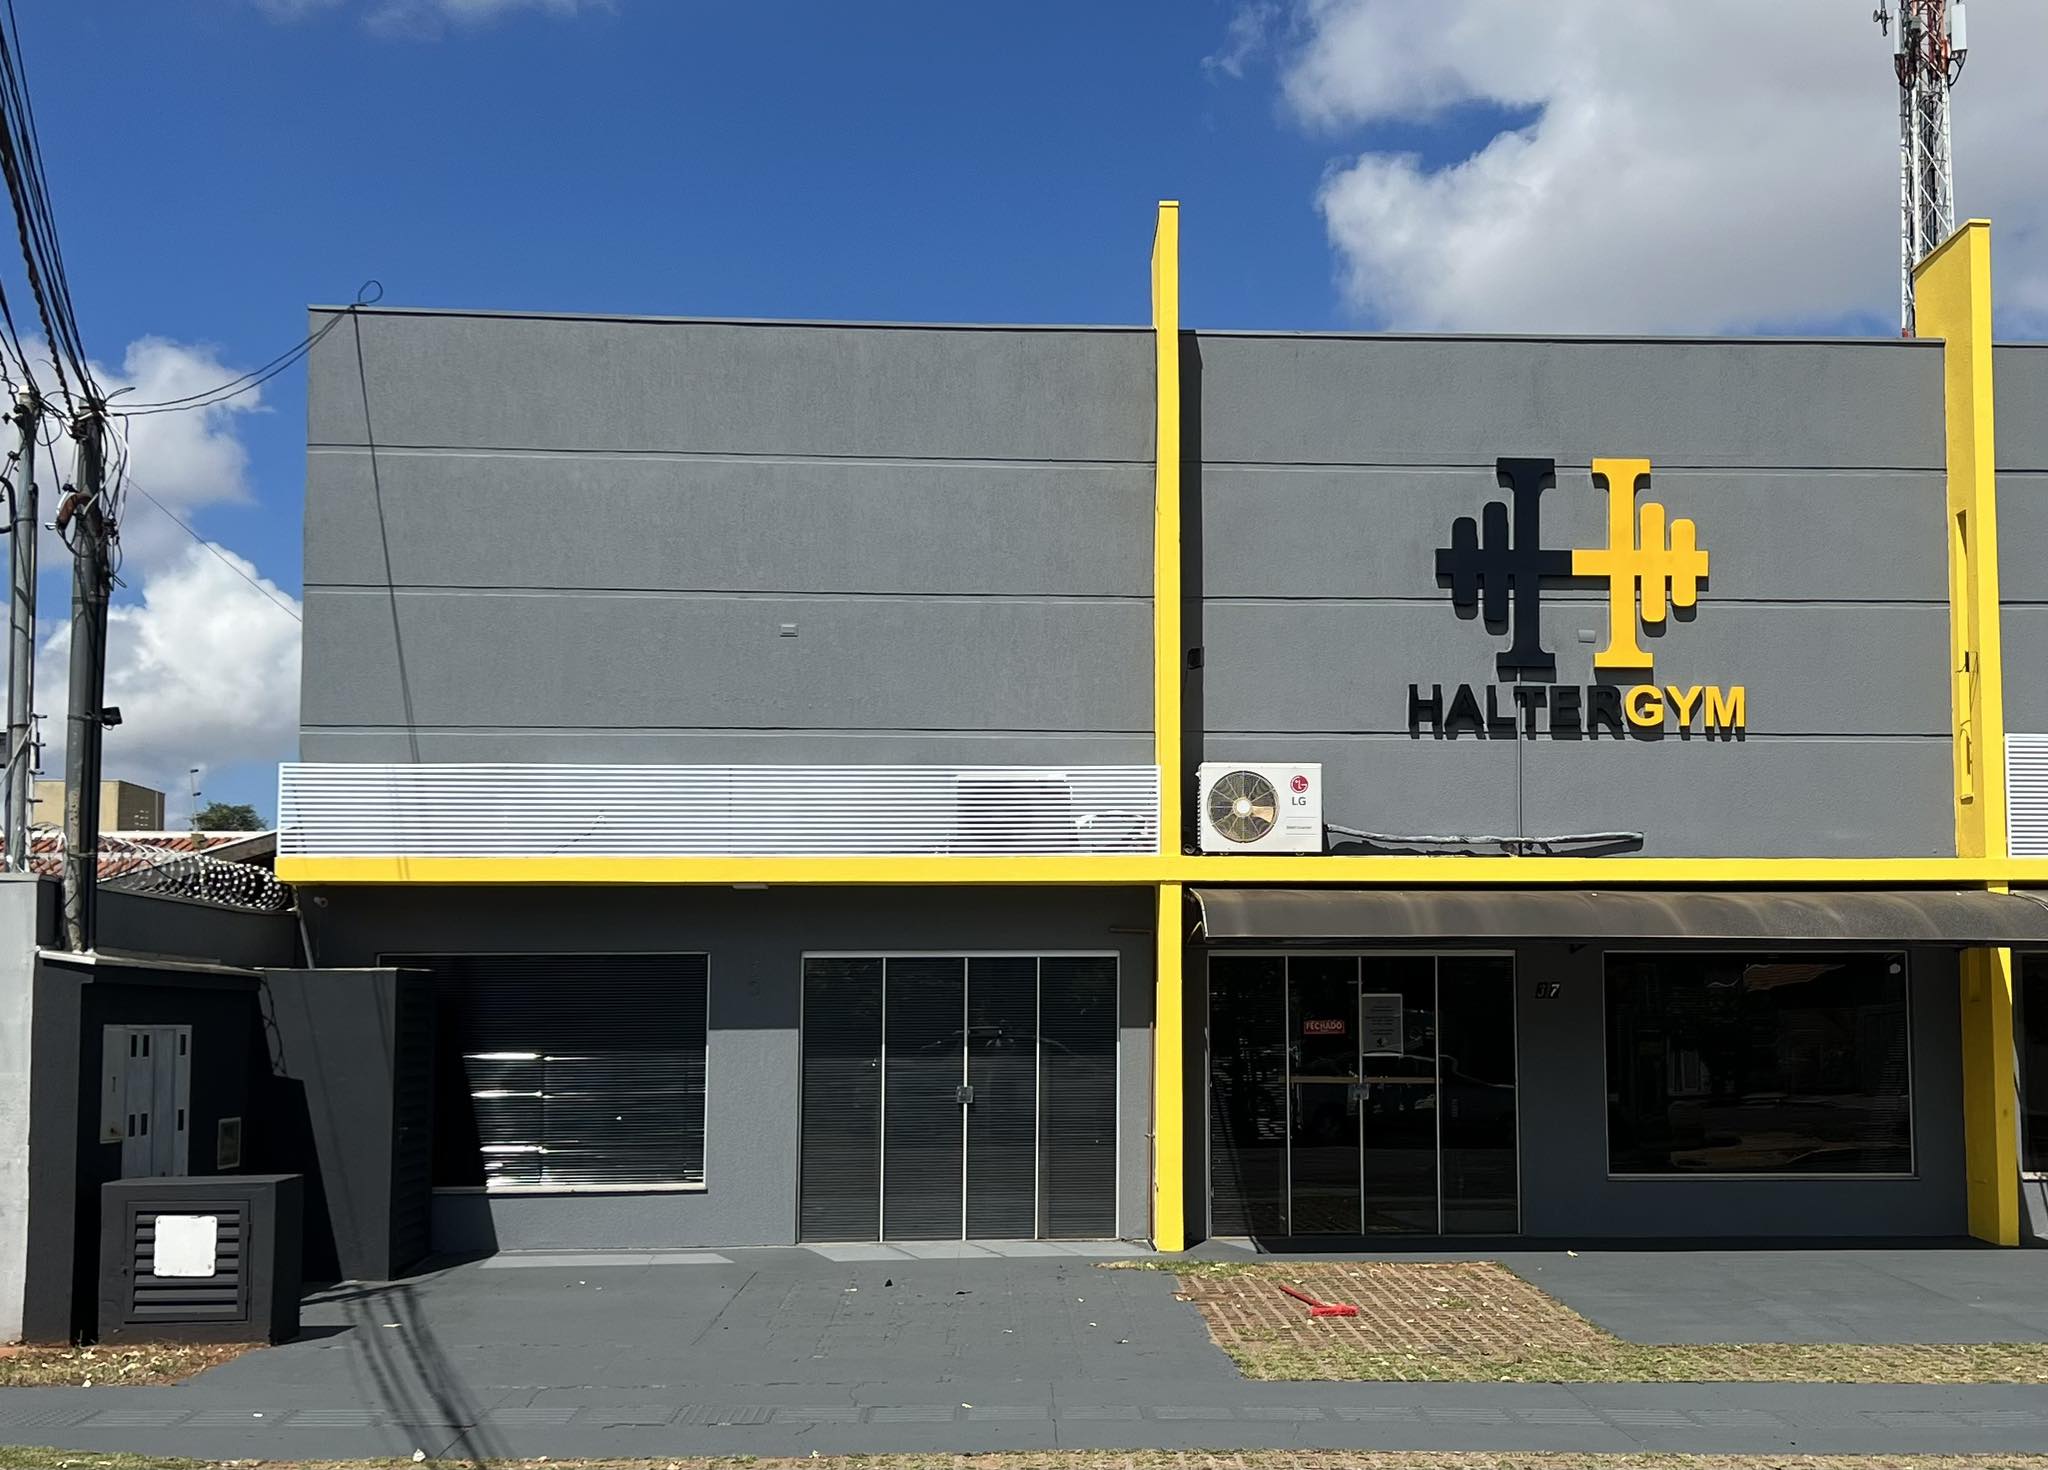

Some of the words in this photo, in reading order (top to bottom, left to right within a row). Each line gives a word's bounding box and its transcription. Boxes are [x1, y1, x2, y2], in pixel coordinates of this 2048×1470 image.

[1408, 684, 1745, 728] HALTERGYM
[1292, 796, 1306, 806] LG
[1305, 1020, 1343, 1031] FECHADO
